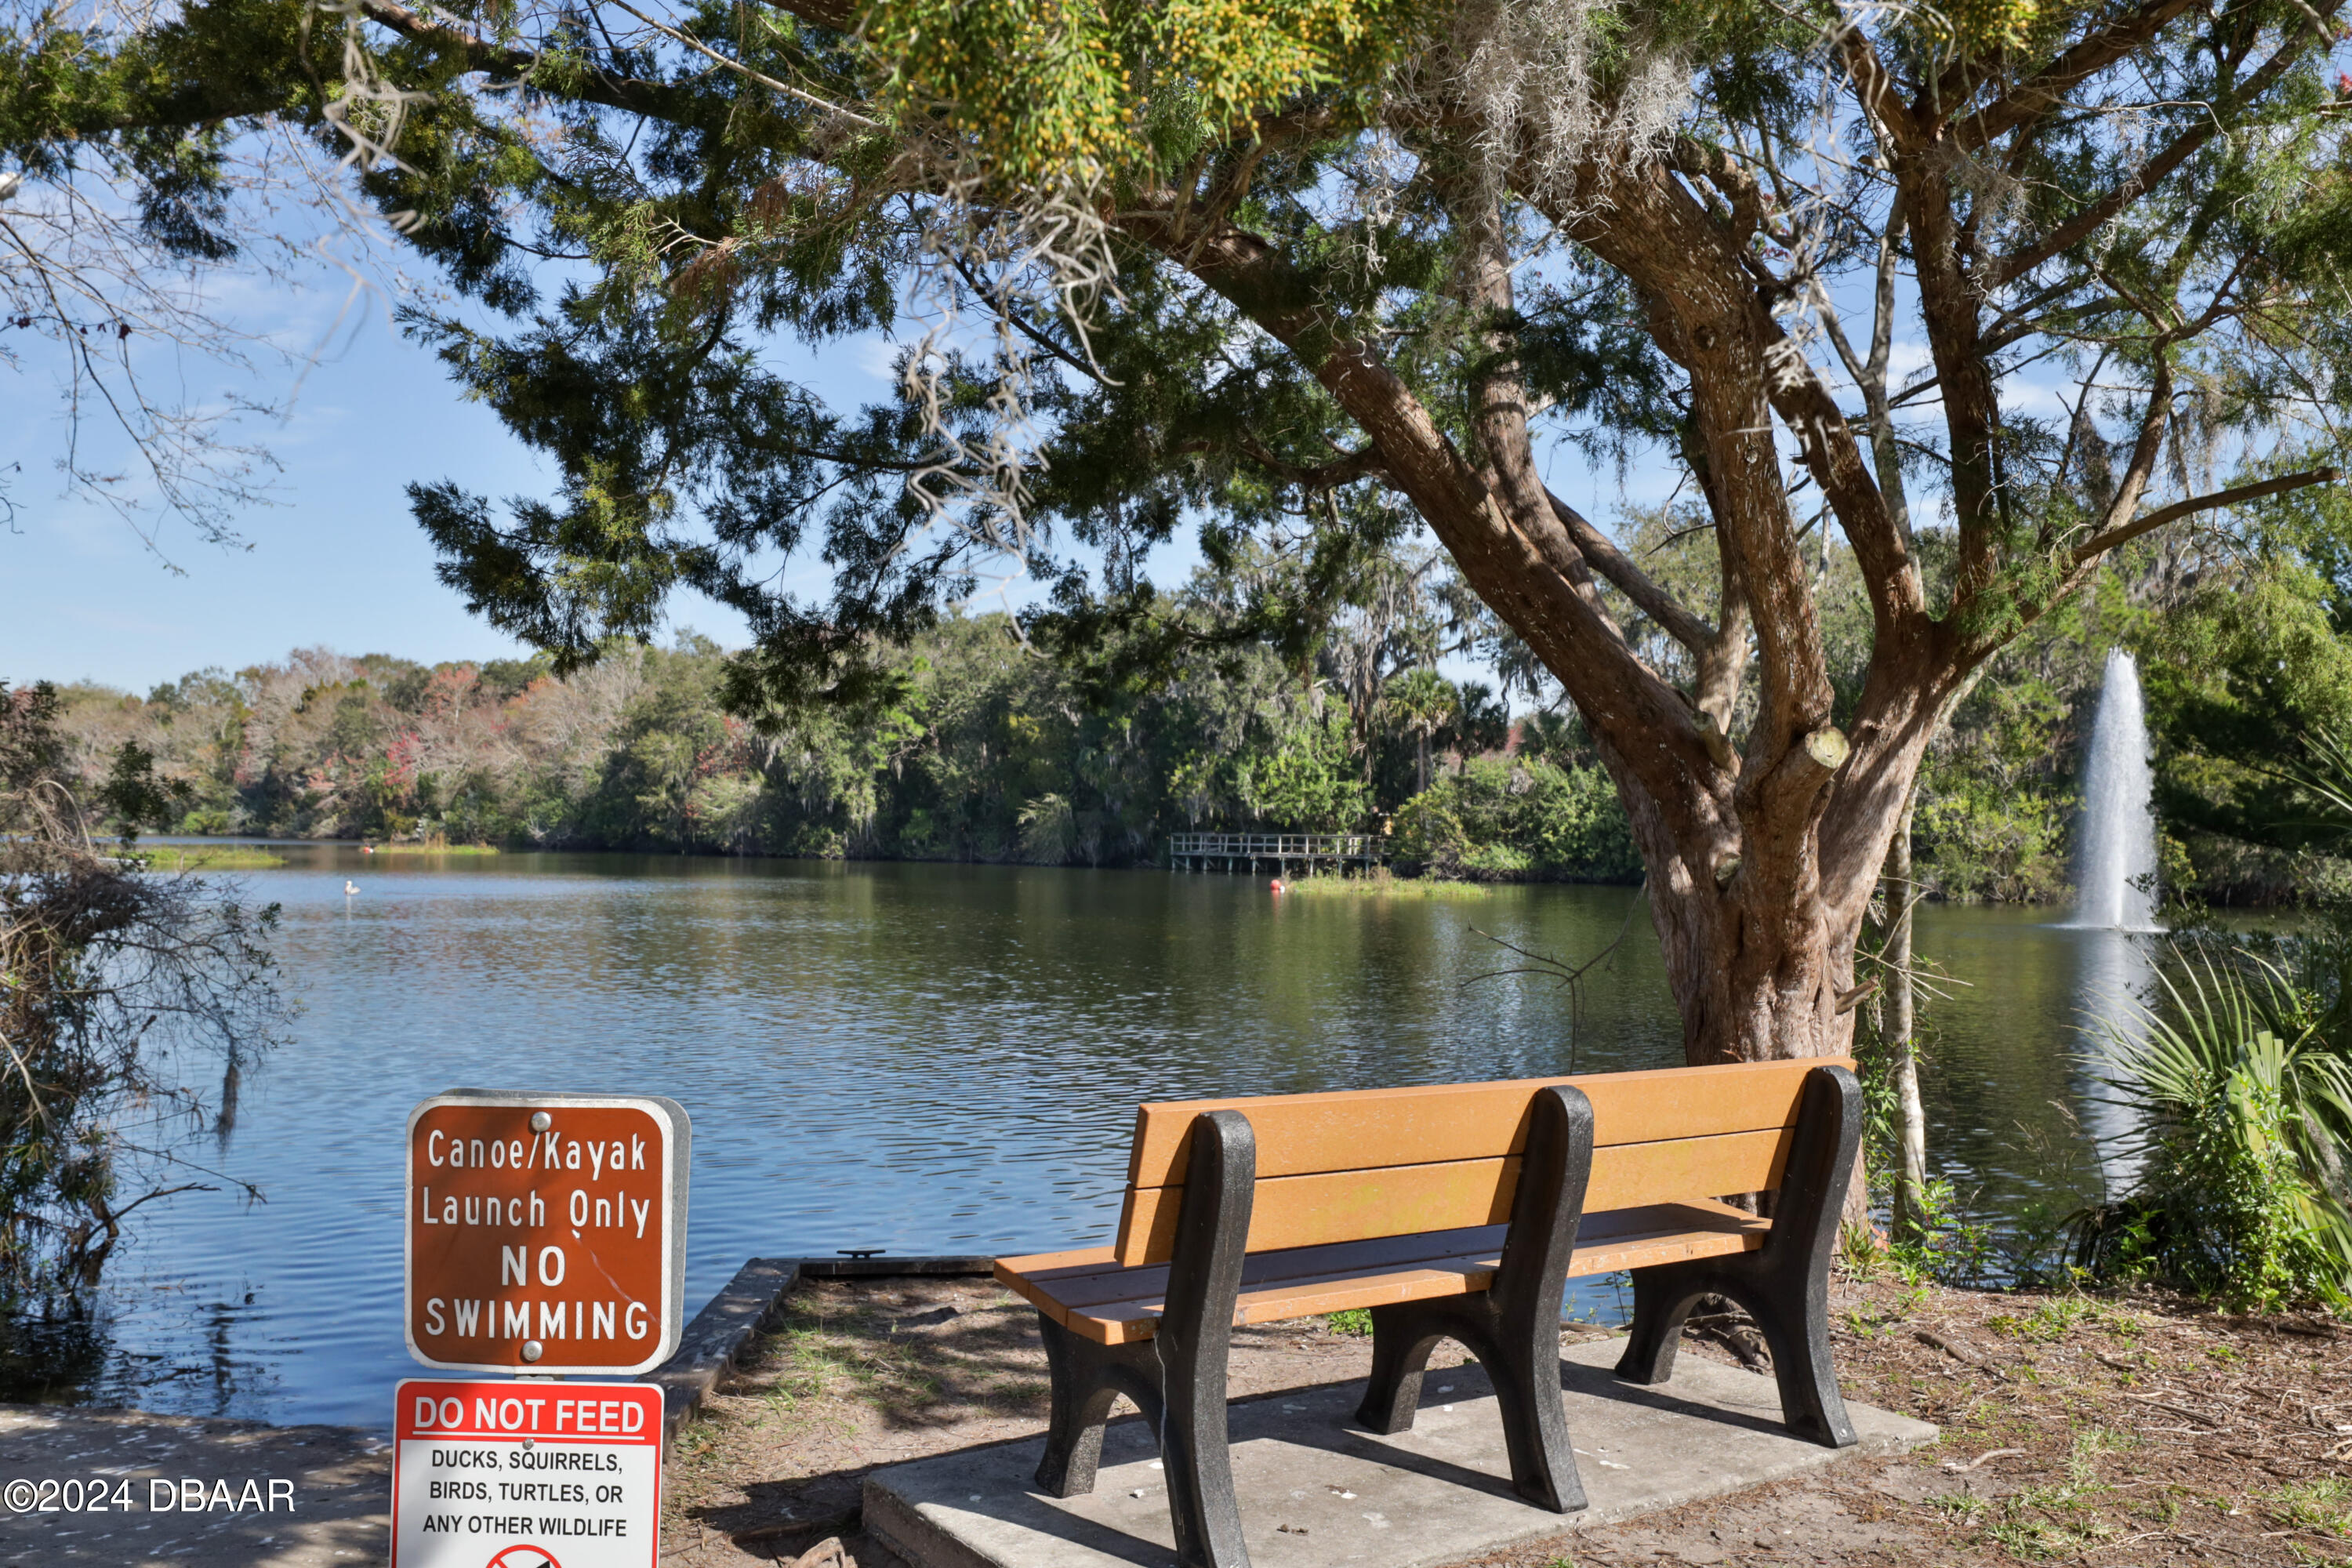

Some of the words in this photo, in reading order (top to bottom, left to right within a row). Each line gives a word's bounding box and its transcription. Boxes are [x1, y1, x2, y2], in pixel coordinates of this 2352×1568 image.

[428, 1130, 646, 1181] Canoe/Kayak
[423, 1186, 545, 1227] Launch
[569, 1189, 650, 1239] Only
[502, 1245, 566, 1287] NO
[425, 1298, 648, 1340] SWIMMING
[415, 1396, 464, 1428] DO
[475, 1398, 546, 1430] NOT
[556, 1399, 644, 1433] FEED
[432, 1450, 503, 1472] DUCKS,
[509, 1451, 622, 1474] SQUIRRELS,
[430, 1481, 492, 1503] BIRDS,
[499, 1483, 589, 1505] TURTLES,
[596, 1486, 623, 1503] OR
[423, 1515, 463, 1533] ANY
[468, 1515, 533, 1535] OTHER
[539, 1518, 627, 1537] WILDLIFE
